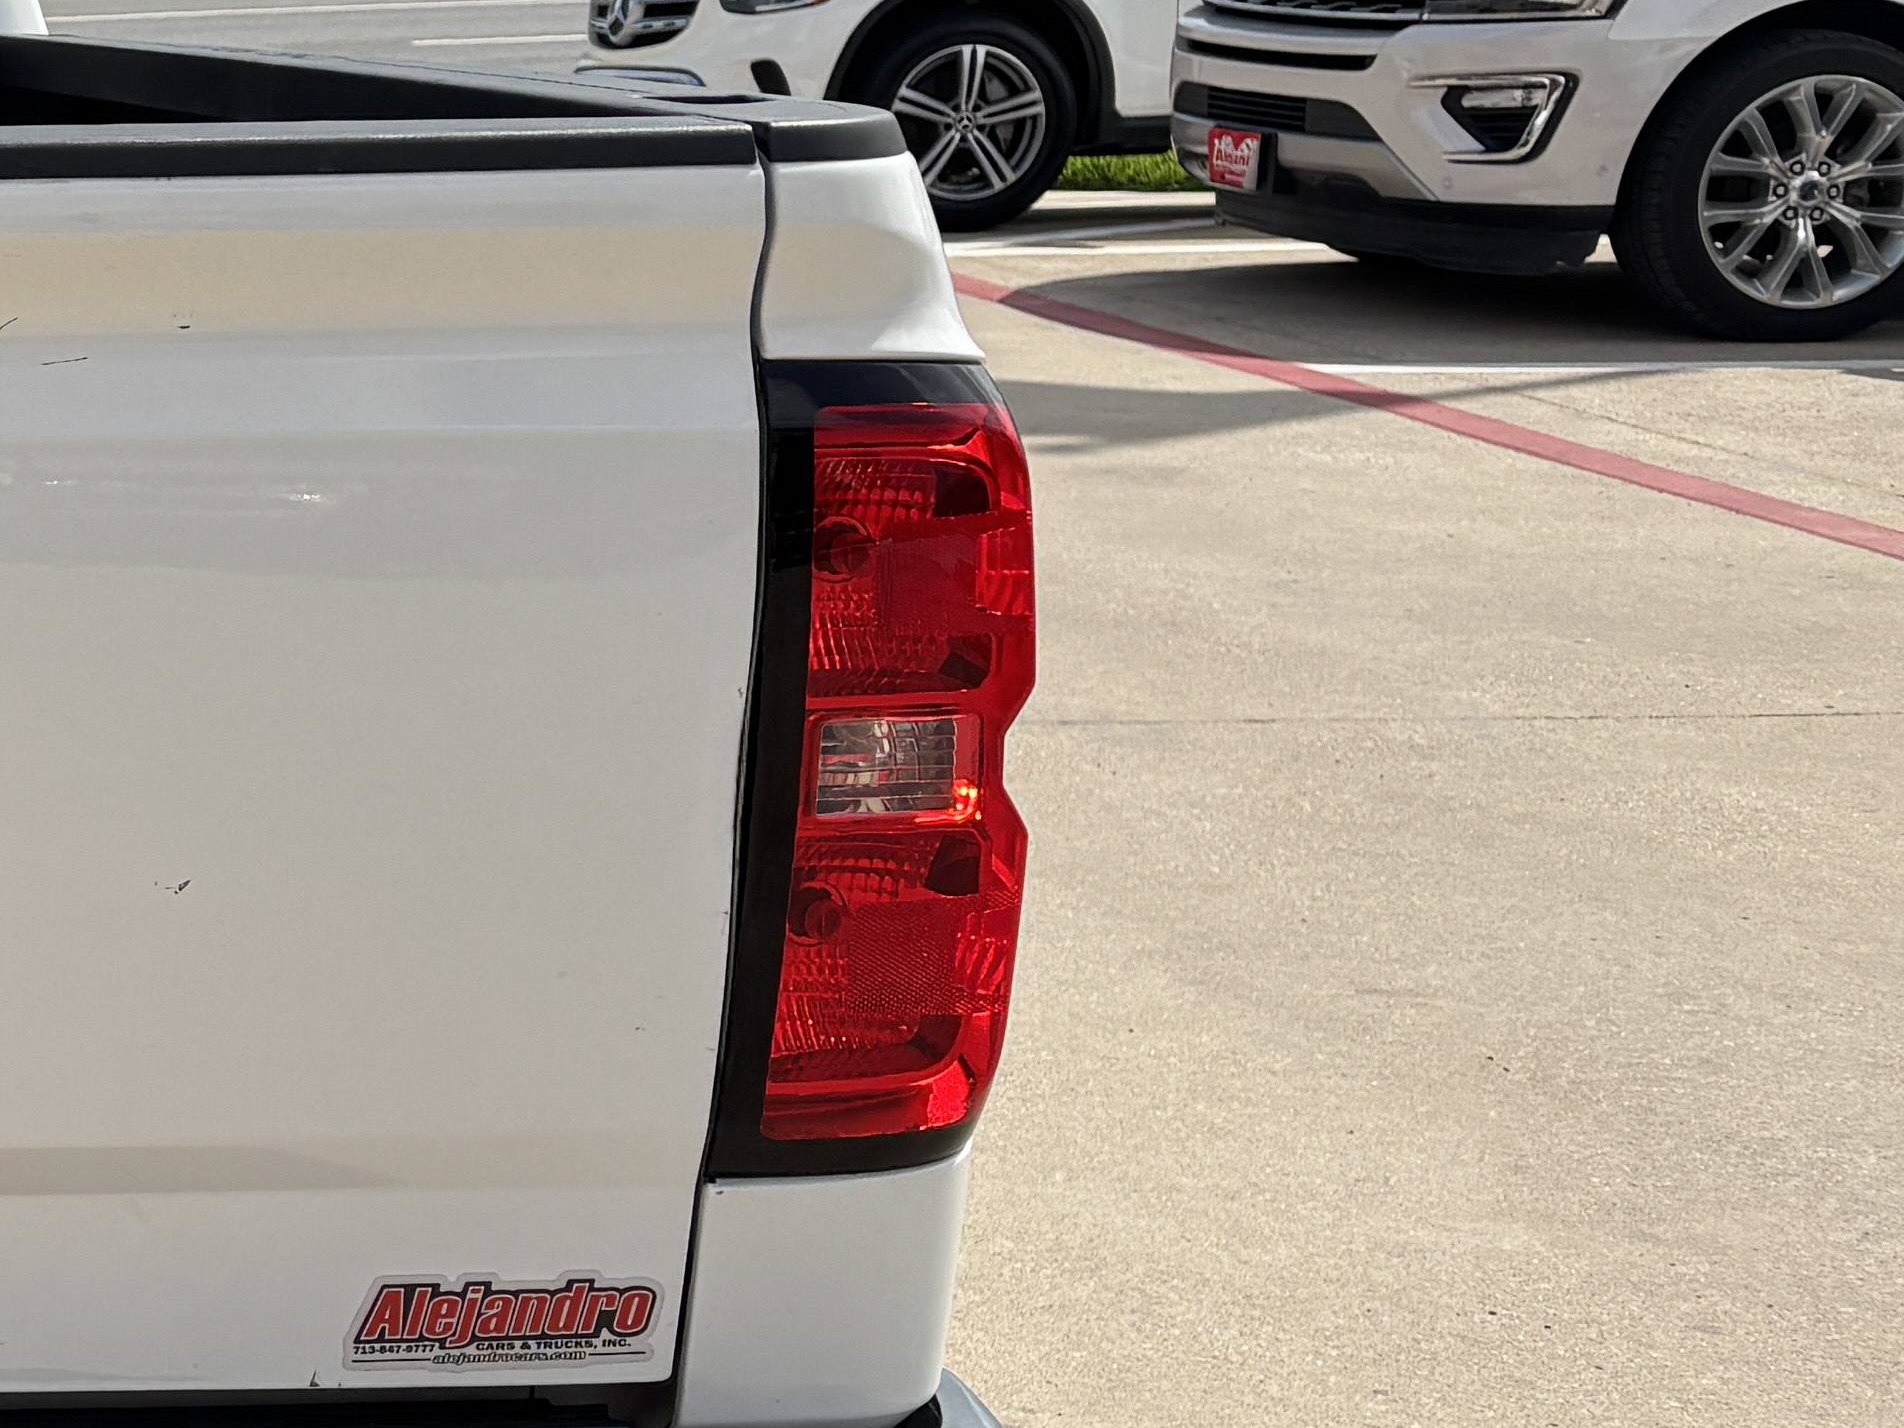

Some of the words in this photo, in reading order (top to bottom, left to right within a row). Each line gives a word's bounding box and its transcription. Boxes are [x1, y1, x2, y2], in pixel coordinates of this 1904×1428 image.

[356, 1283, 654, 1346] Alejandro
[476, 1340, 516, 1351] CARS
[520, 1340, 532, 1350] &
[602, 1338, 632, 1348] INC.
